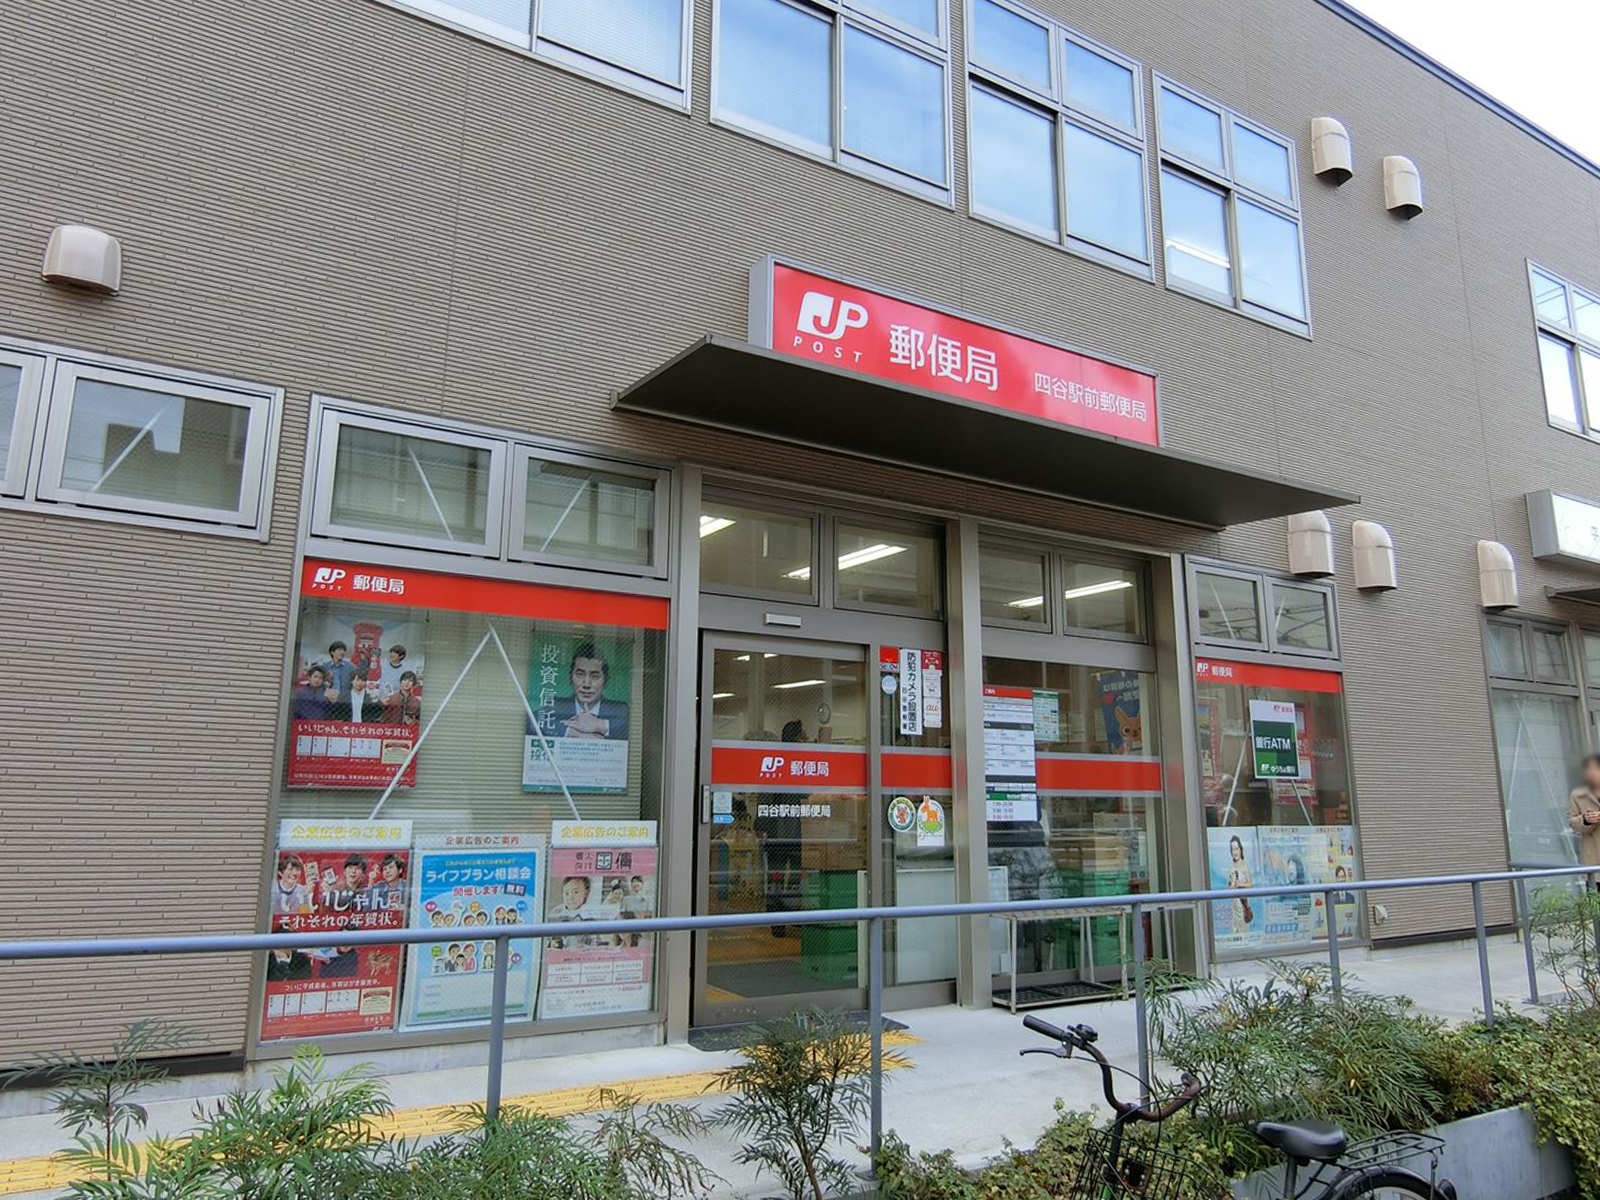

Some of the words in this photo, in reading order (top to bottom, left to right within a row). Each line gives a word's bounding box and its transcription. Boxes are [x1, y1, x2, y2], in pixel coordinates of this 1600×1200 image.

[793, 335, 863, 363] POST
[796, 291, 868, 340] JP
[889, 323, 998, 392] 郵便局
[1034, 372, 1147, 422] 四谷駅前郵便局
[314, 567, 346, 584] JP
[352, 574, 404, 595] 郵便局
[537, 644, 559, 730] 投資信託
[907, 651, 917, 732] 防犯カメラ設置店
[1255, 736, 1291, 750] 銀行ATM
[760, 757, 784, 772] JP
[790, 761, 829, 777] 郵便局
[757, 804, 831, 818] 四谷駅前郵便局
[291, 825, 402, 839] 企業広告のご案内
[445, 836, 520, 845] 企業広告のご案内
[561, 826, 649, 838] 企業広告のご案内
[426, 866, 531, 883] ライフプラン相談会
[505, 884, 525, 895] 無料
